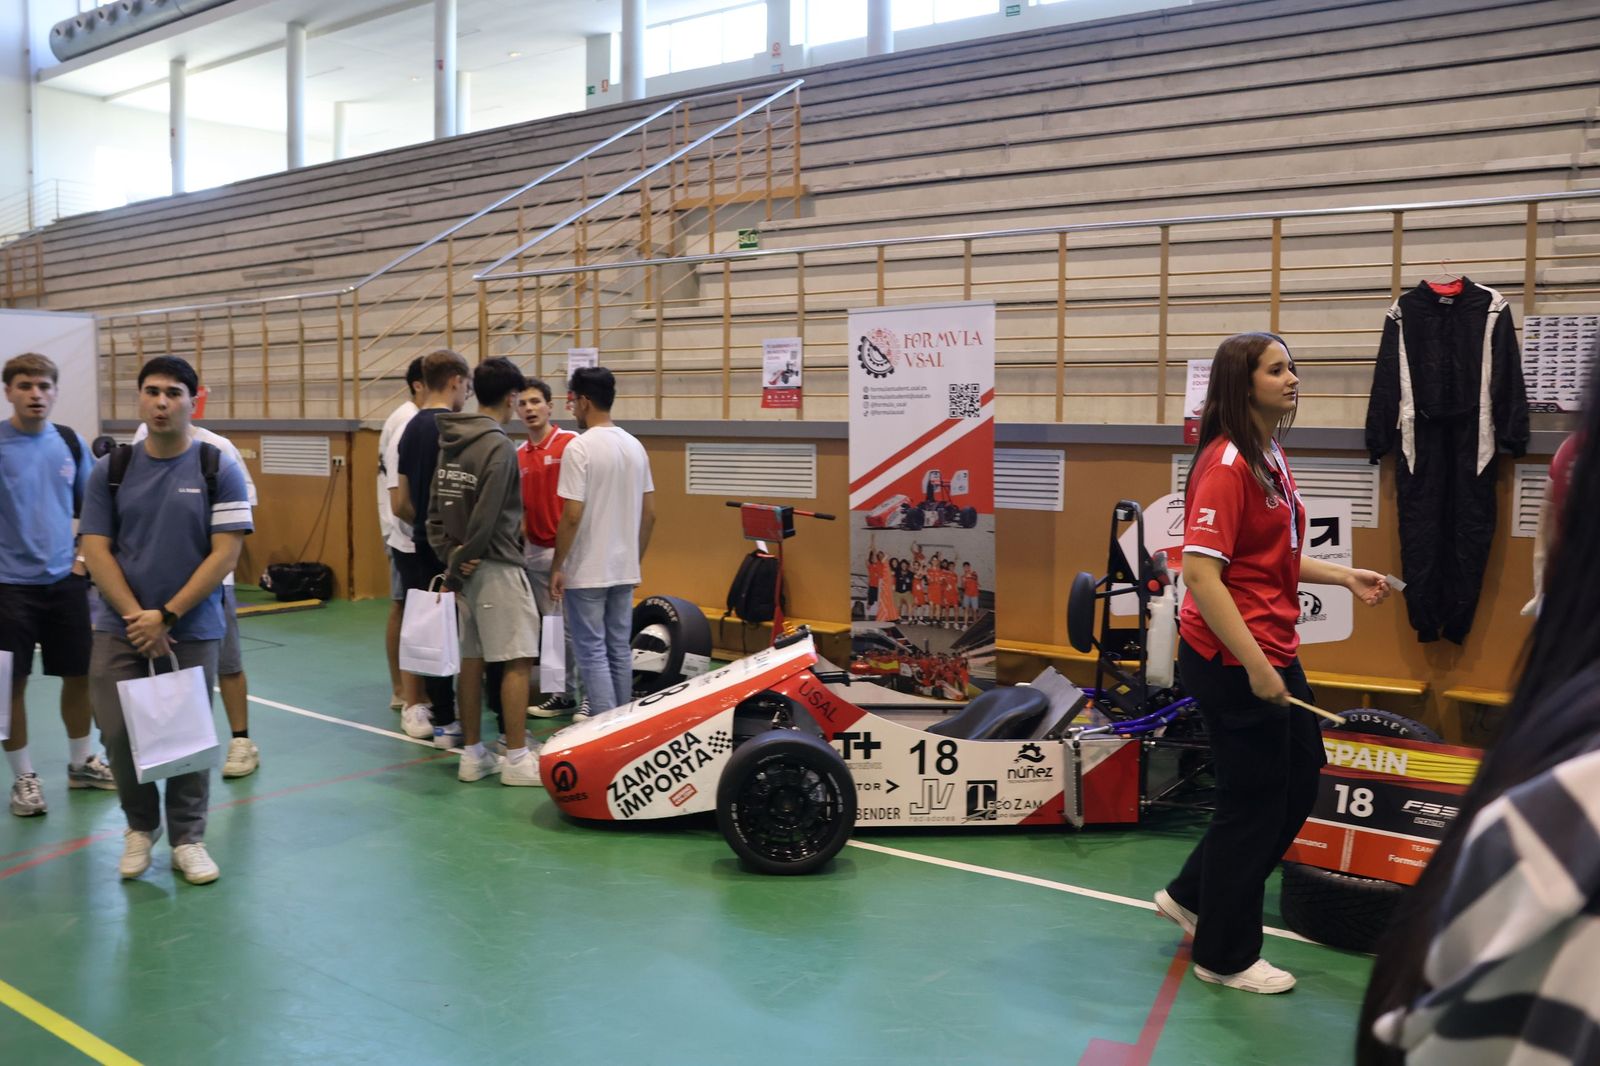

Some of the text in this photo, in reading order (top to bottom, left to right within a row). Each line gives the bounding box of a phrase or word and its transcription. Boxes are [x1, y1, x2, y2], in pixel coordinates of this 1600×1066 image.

[799, 681, 837, 723] USAL
[606, 730, 702, 802] ZAMORA
[910, 739, 959, 776] 18
[1334, 783, 1374, 818] 18
